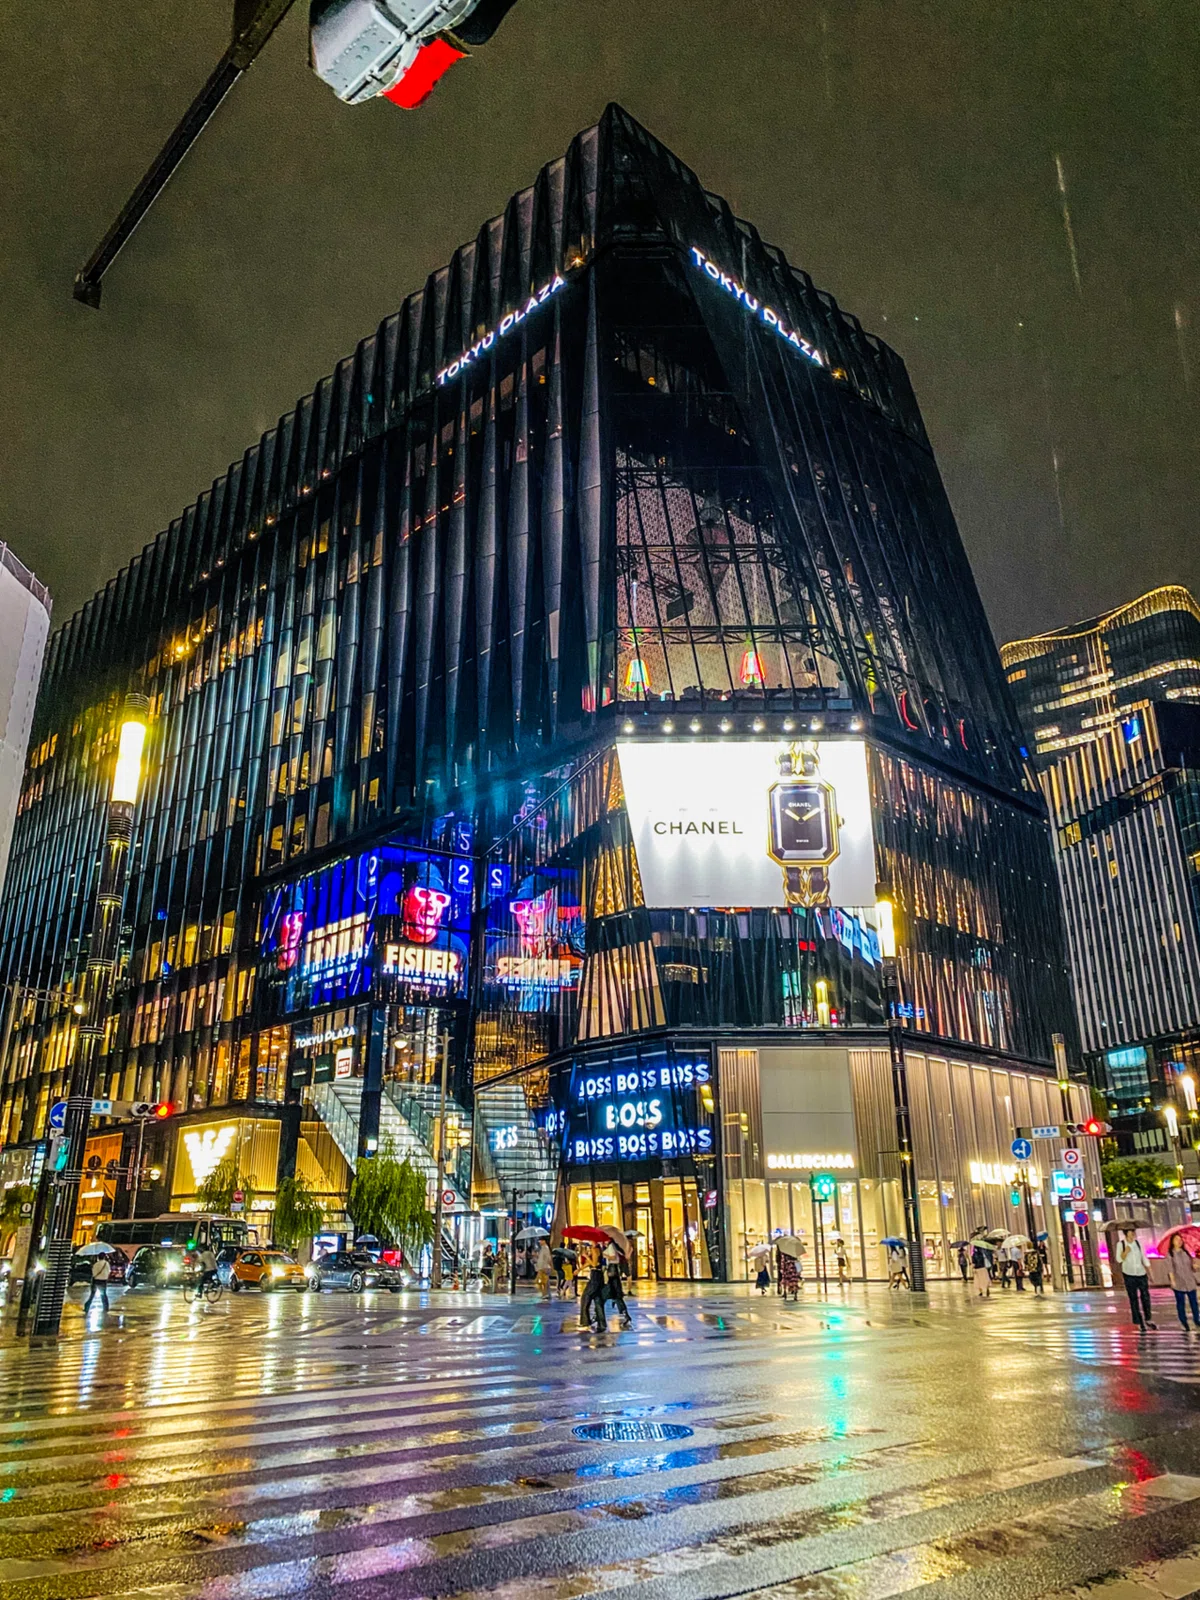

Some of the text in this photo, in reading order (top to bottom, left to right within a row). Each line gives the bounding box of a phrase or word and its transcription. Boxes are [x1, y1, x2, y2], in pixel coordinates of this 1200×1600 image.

[690, 246, 826, 367] TOKYU PLAZA
[436, 274, 566, 387] TOKYU PLAZA
[653, 820, 744, 836] CHANEL
[295, 1026, 356, 1049] TOKYU PLAZA
[661, 1064, 710, 1086] BOSS
[605, 1099, 663, 1130] BOSS
[620, 1133, 658, 1154] BOSS
[767, 1154, 855, 1169] BALENCIAGA
